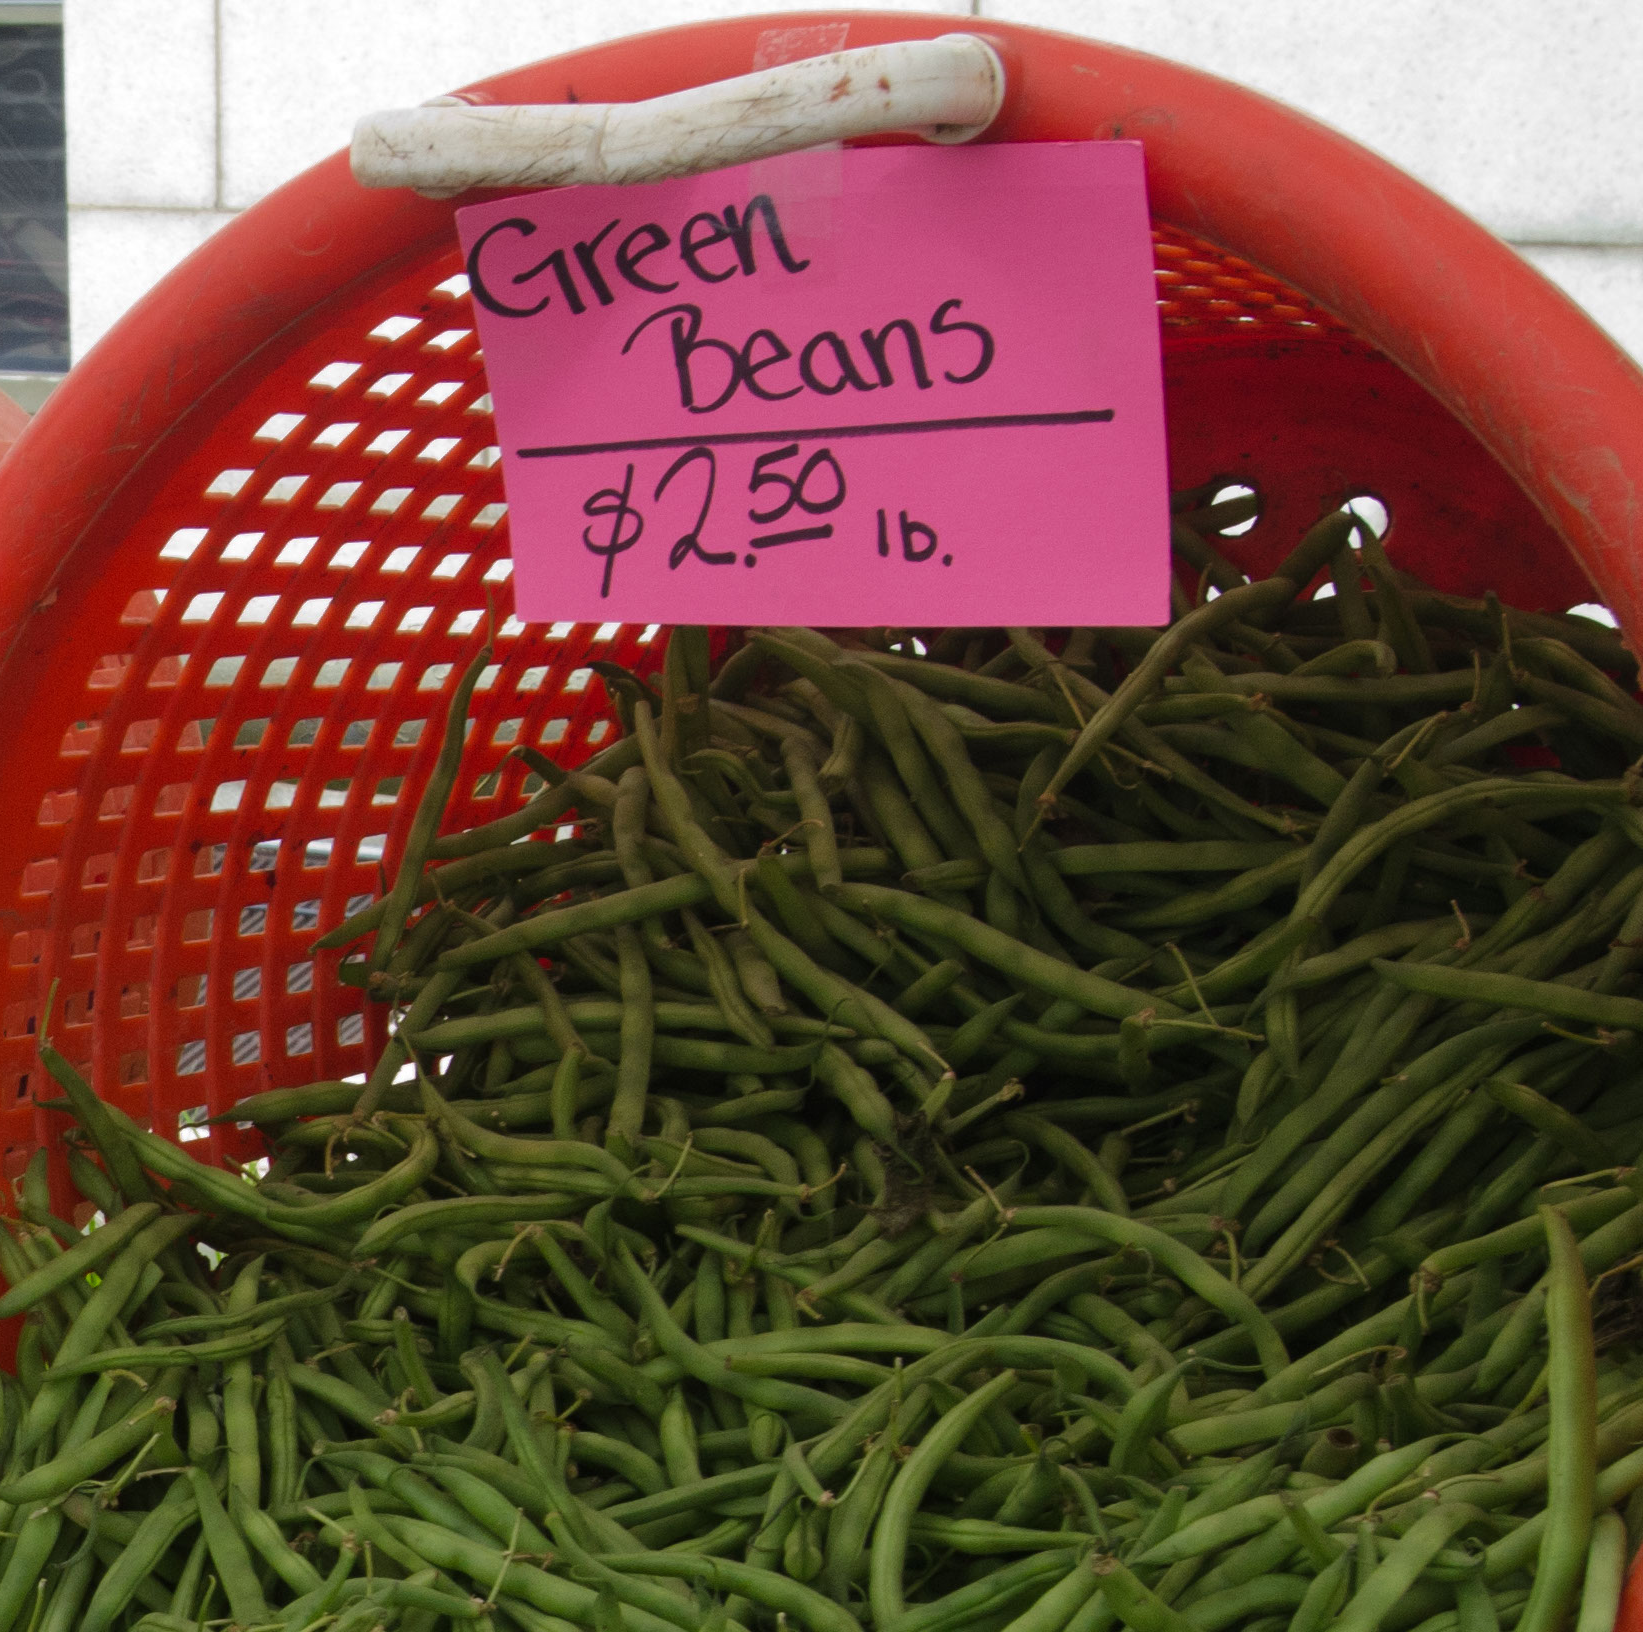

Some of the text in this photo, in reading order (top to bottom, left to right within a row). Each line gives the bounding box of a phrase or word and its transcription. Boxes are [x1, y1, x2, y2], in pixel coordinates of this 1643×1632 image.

[466, 194, 811, 319] Green
[621, 298, 995, 414] Beans
[877, 509, 954, 566] lb.
